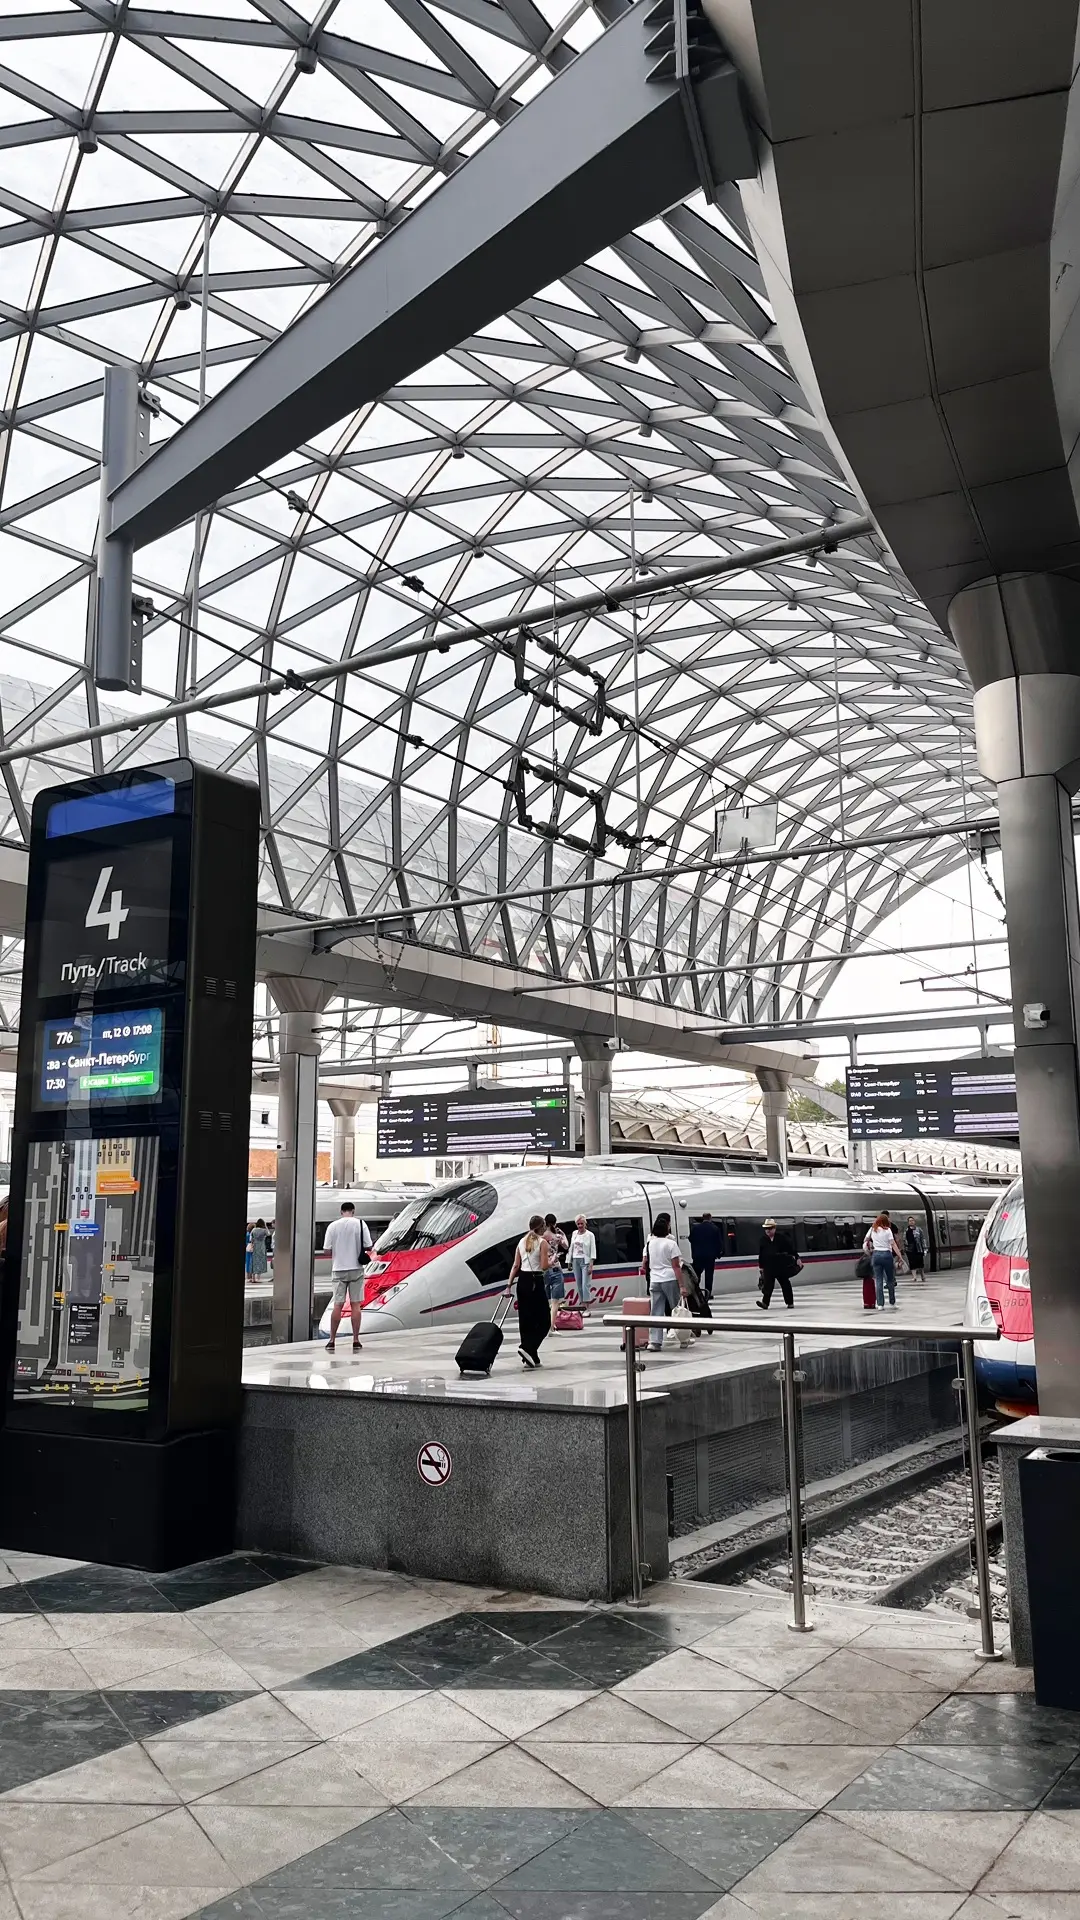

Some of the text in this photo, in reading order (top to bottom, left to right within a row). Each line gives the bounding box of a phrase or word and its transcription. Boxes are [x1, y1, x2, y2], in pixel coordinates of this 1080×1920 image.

[85, 866, 129, 940] 4
[61, 952, 147, 983] Путь/Track
[56, 1032, 73, 1045] 776
[113, 1028, 122, 1038] 12
[132, 1024, 152, 1036] 17:08
[67, 1050, 151, 1069] Санкт-Петербург
[46, 1079, 66, 1090] 17:30
